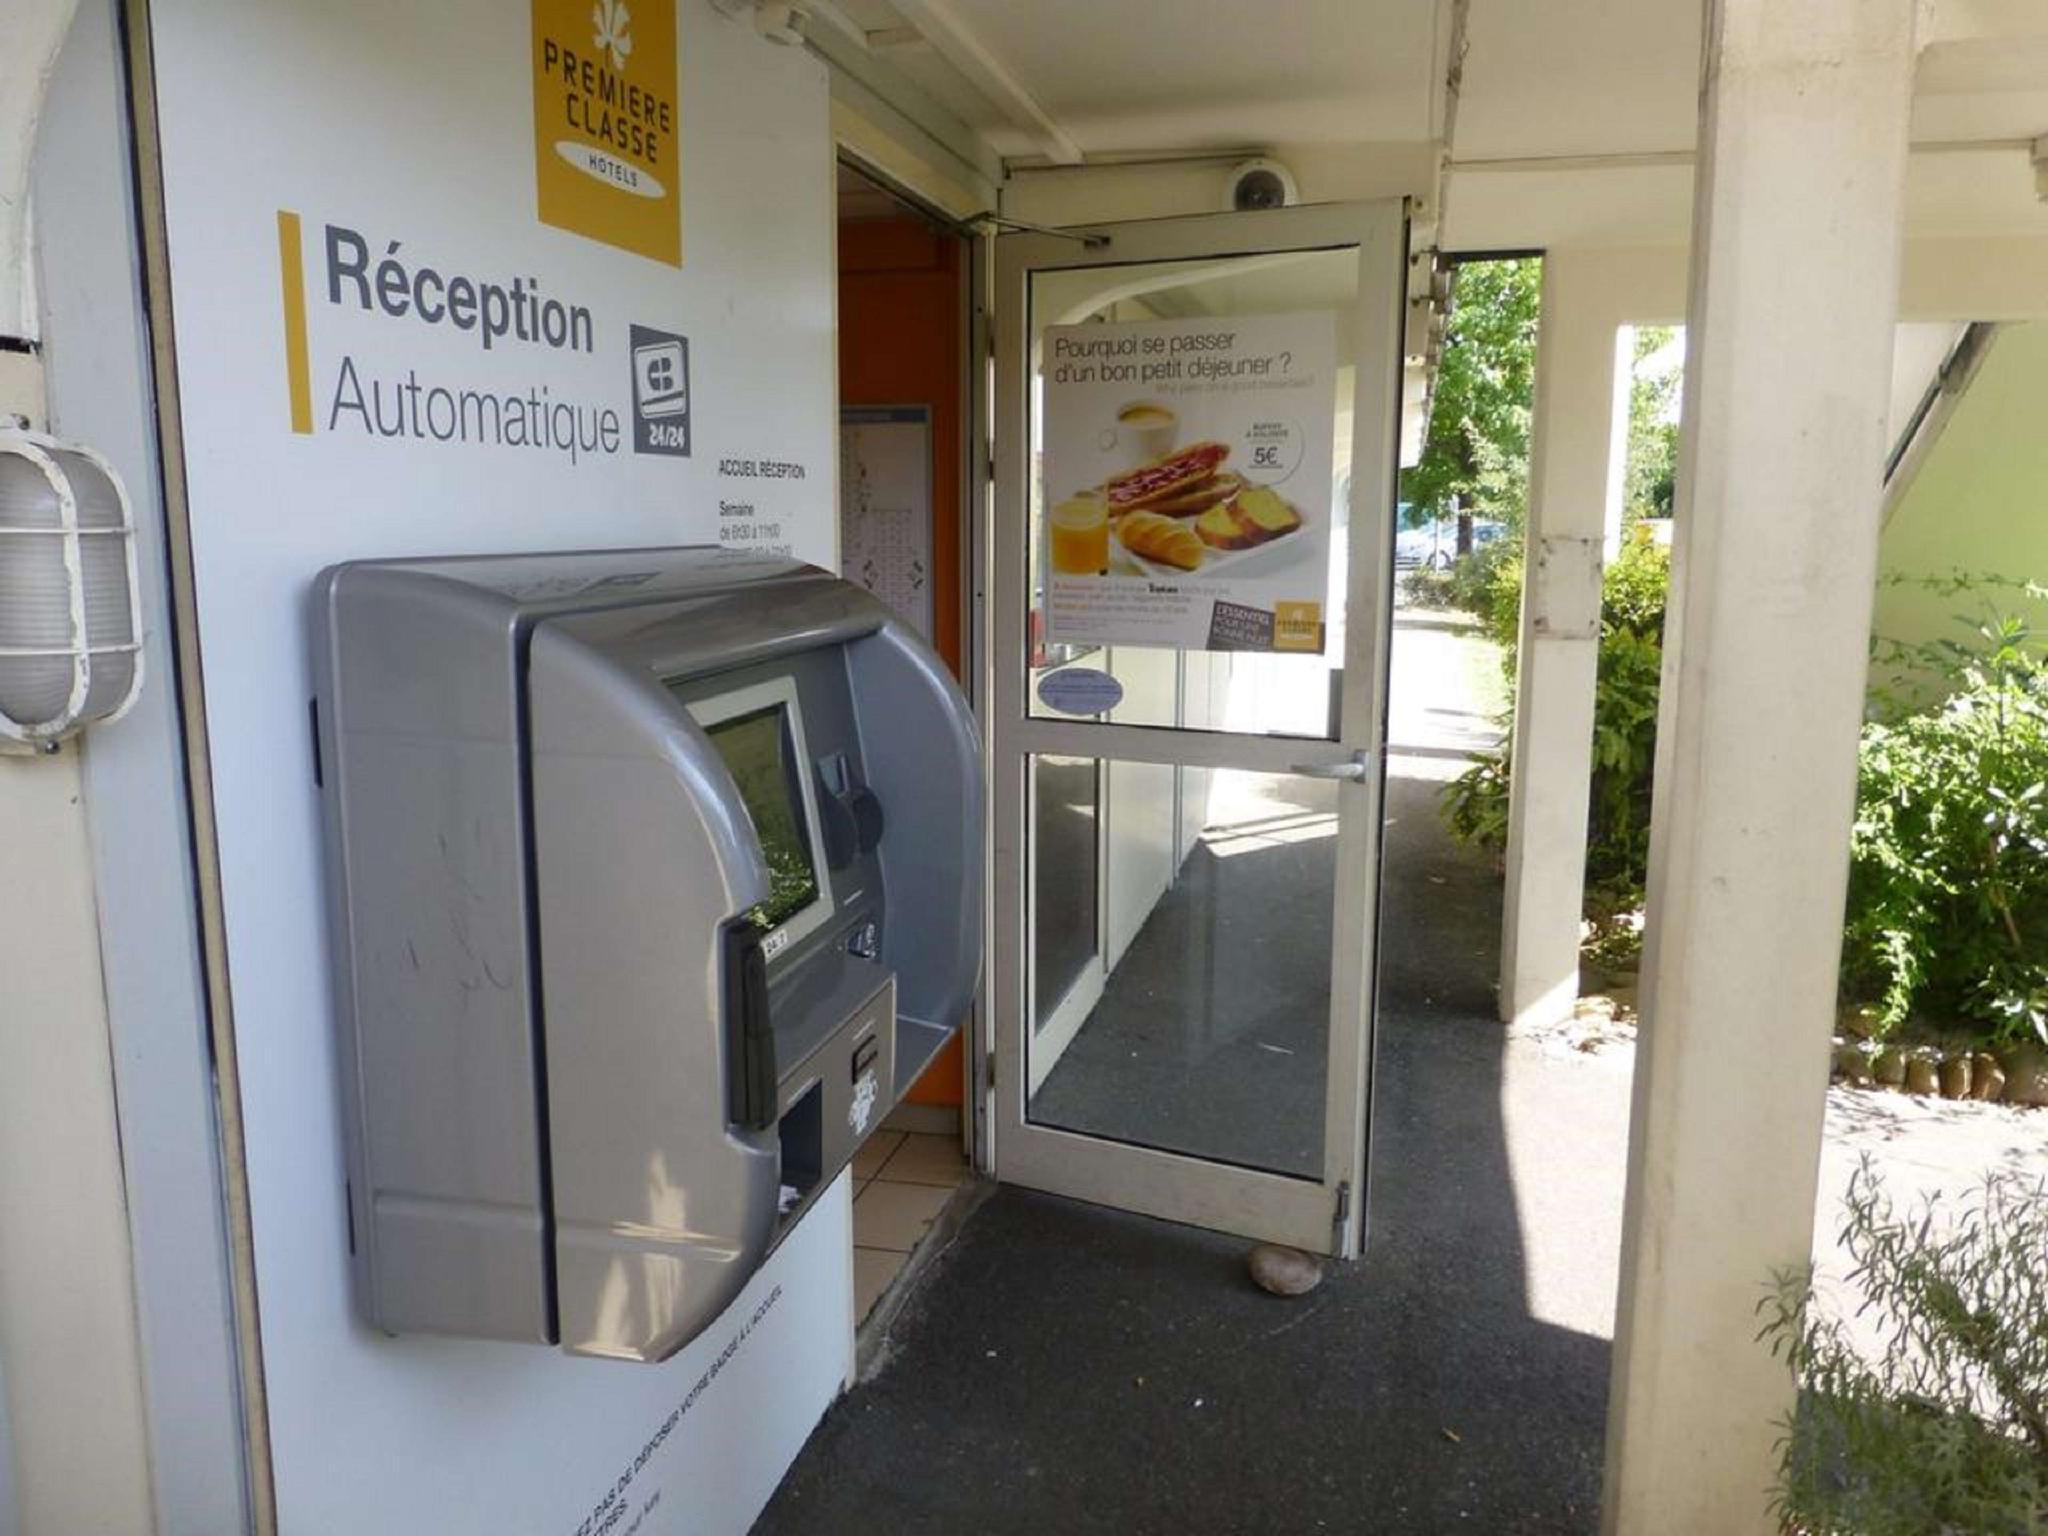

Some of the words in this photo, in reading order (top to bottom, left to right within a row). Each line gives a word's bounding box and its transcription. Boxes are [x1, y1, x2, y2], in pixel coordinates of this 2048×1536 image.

[544, 37, 670, 134] PREMIERE
[567, 93, 657, 164] CLASSE
[588, 153, 638, 187] HOTELS
[325, 223, 594, 353] Réception
[1055, 335, 1138, 361] Pourquoi
[1142, 337, 1165, 354] se
[1170, 332, 1236, 356] passer
[1055, 363, 1096, 384] d'un
[1101, 361, 1137, 382] bon
[1141, 359, 1182, 385] petit
[1188, 355, 1273, 382] déjeuner
[329, 355, 620, 466] Automatique
[649, 422, 685, 448] 24/24
[719, 459, 757, 477] ACCUEIL
[760, 459, 805, 480] RÉCEPTION
[1253, 446, 1278, 465] 5€
[594, 1488, 615, 1523] PAS
[618, 1466, 632, 1493] DE
[680, 1371, 709, 1414] VOTRE
[710, 1336, 738, 1378] BADGE
